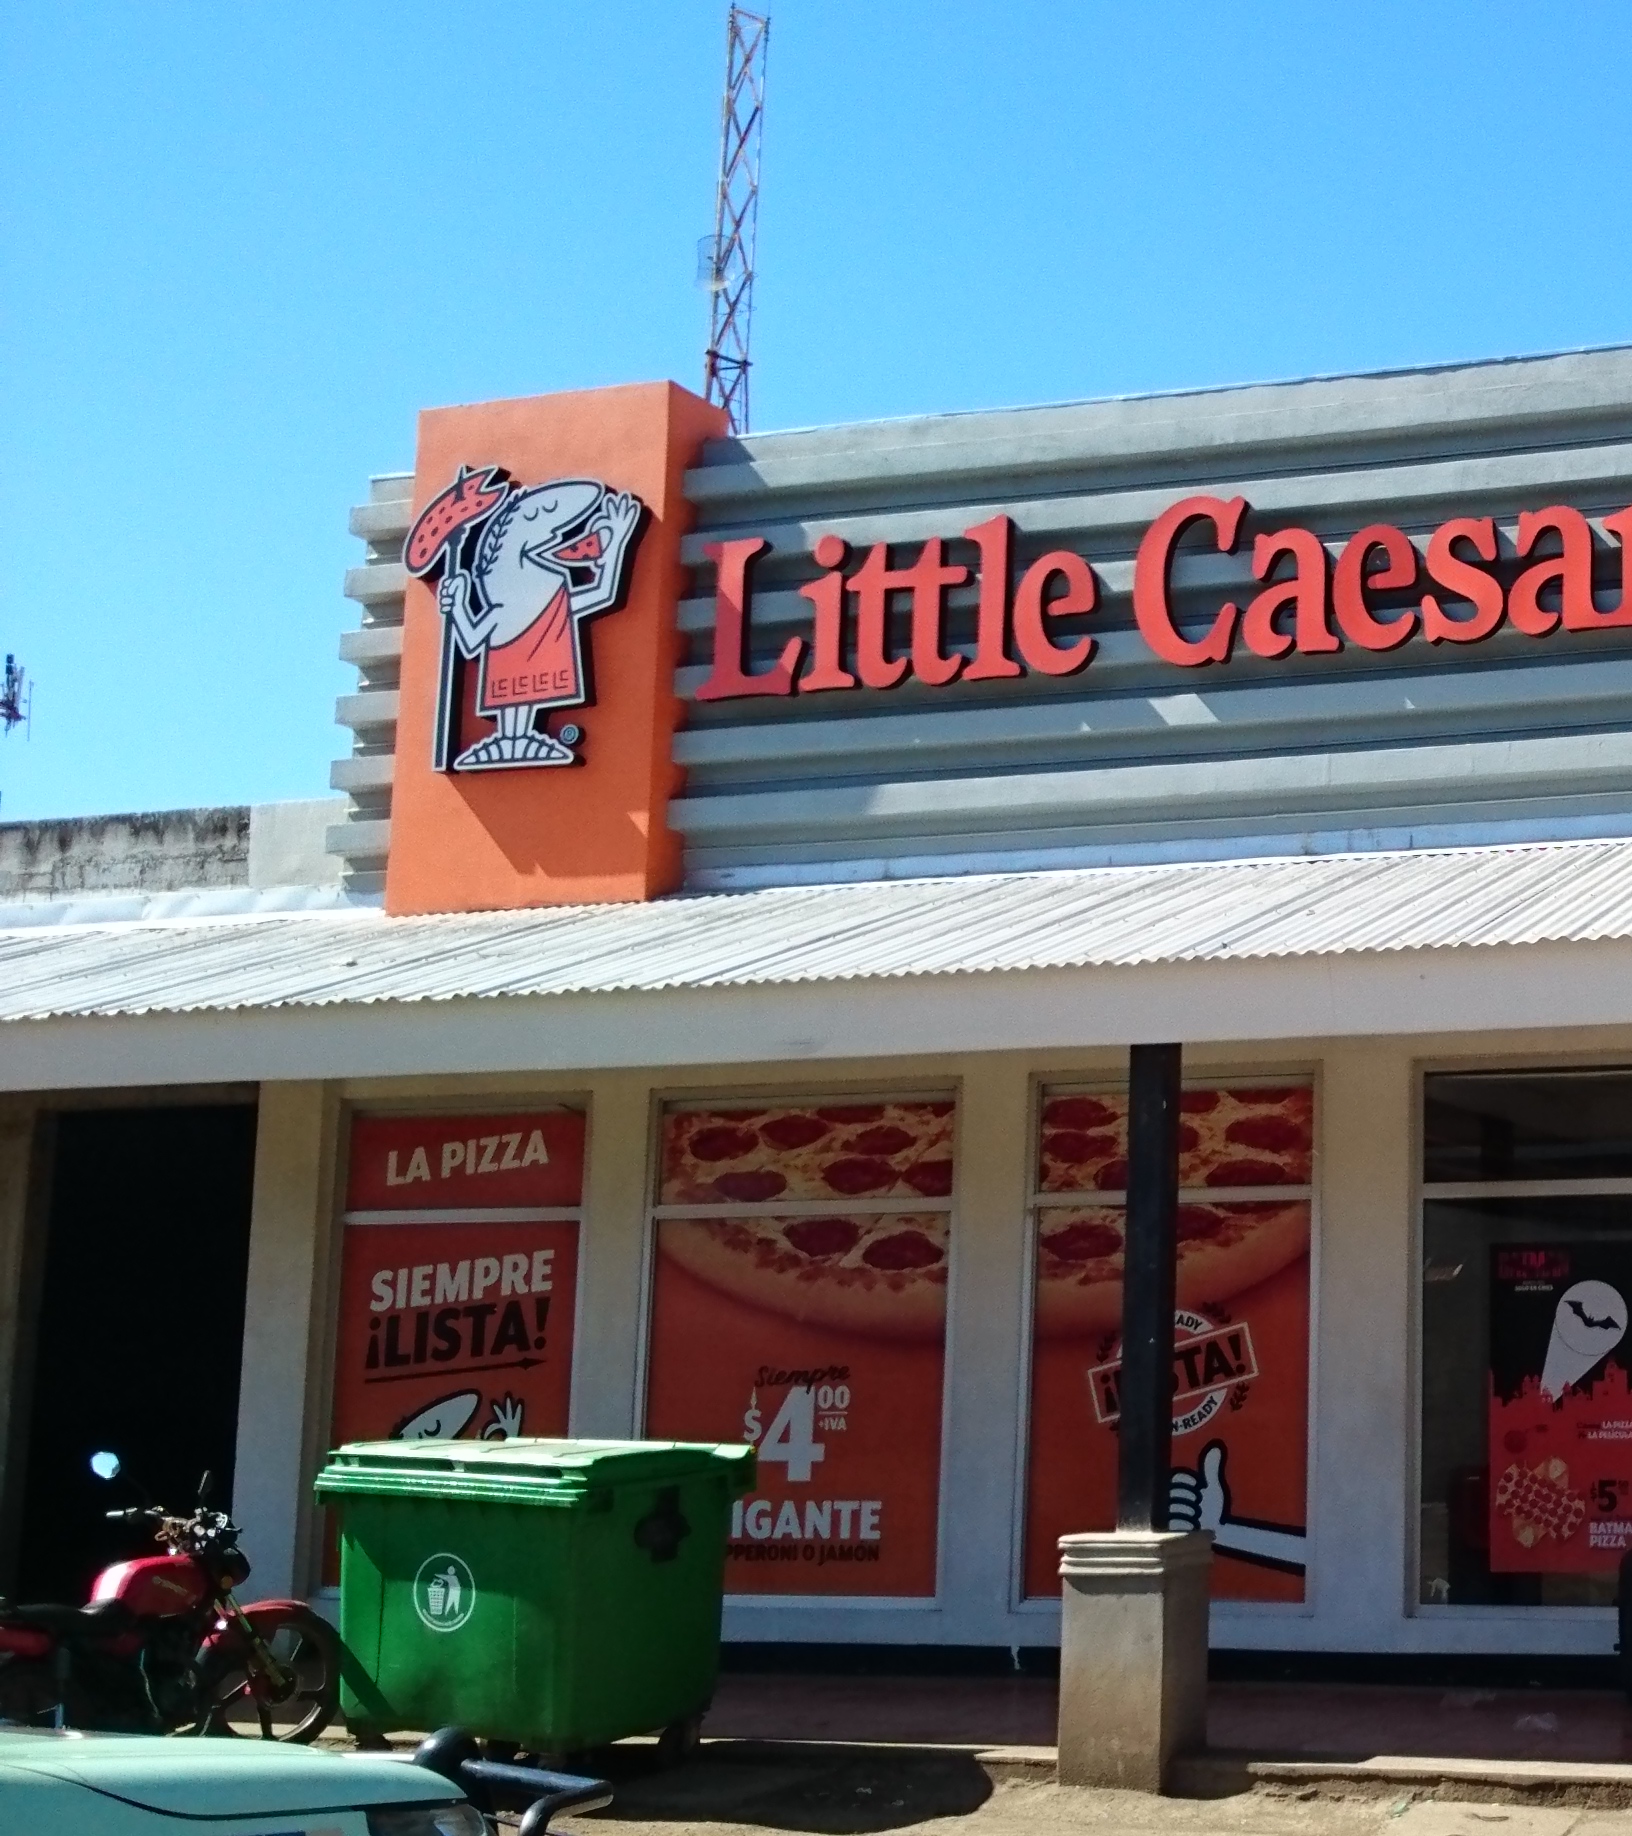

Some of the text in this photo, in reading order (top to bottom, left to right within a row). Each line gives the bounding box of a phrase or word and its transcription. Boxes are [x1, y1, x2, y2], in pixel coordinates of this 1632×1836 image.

[696, 514, 1097, 700] Little
[386, 1129, 549, 1186] LA PIZZA
[370, 1249, 555, 1312] SIEMPRE
[364, 1297, 551, 1369] ¡LISTA!
[755, 1364, 850, 1395] Siempre
[731, 1500, 882, 1540] IGANTE
[1589, 1535, 1627, 1549] PIZZA
[726, 1543, 798, 1562] PPERONI
[803, 1544, 815, 1562] O
